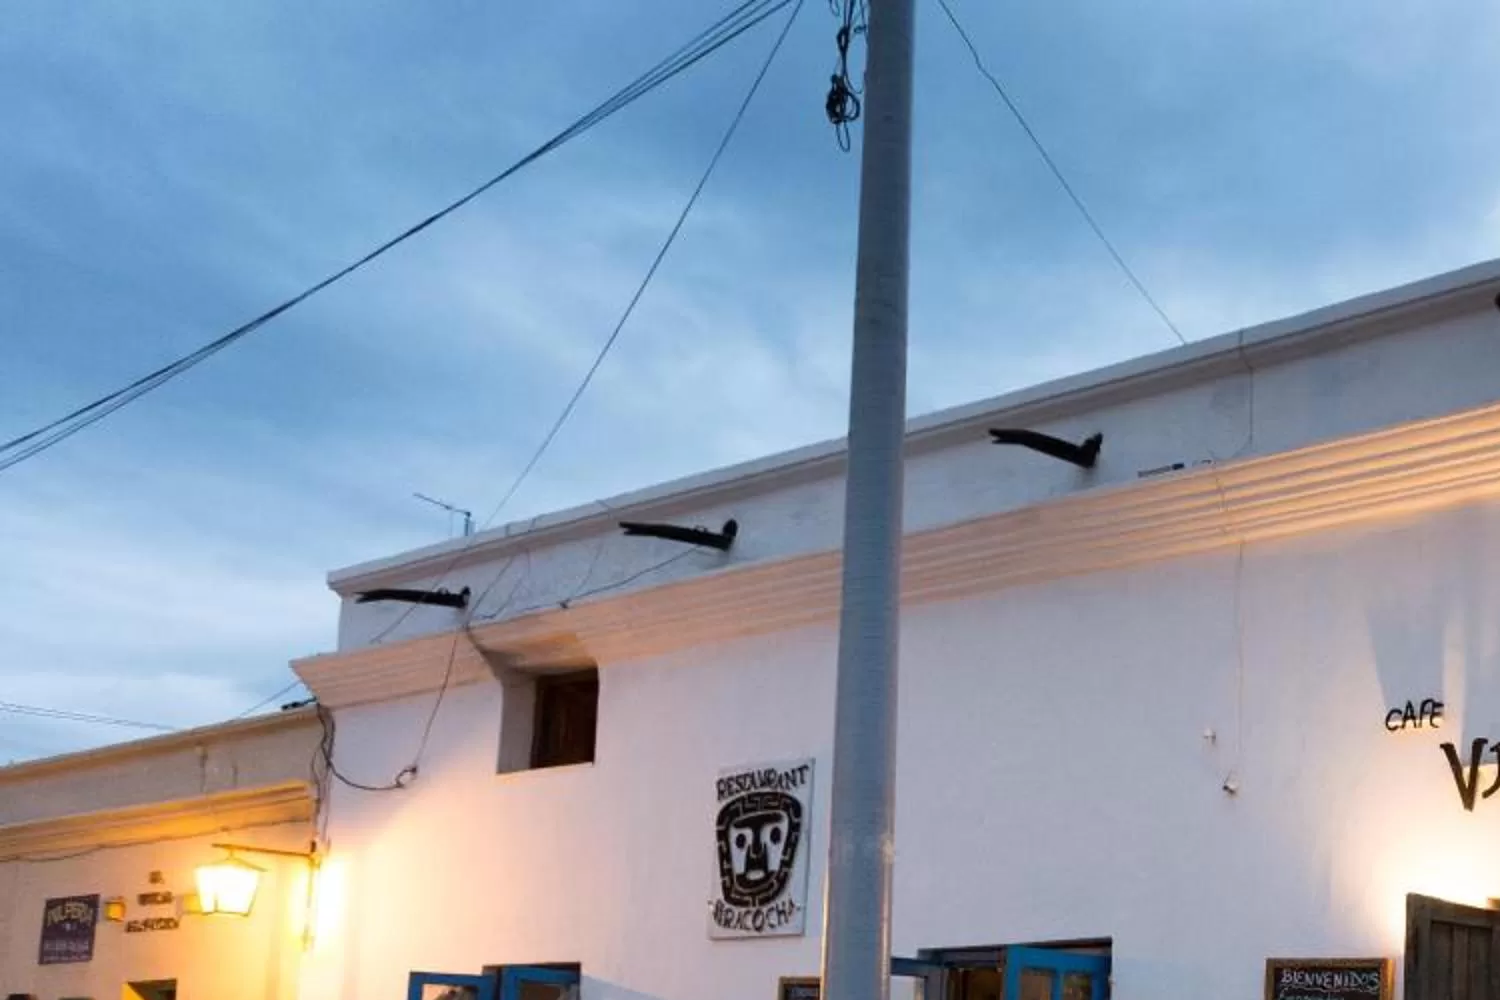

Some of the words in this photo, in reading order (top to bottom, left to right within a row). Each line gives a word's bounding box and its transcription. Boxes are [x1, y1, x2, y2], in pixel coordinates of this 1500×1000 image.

[1385, 698, 1444, 731] CAFE
[716, 764, 809, 801] RESTAURANT
[1280, 968, 1379, 989] BIENVENIDOS
